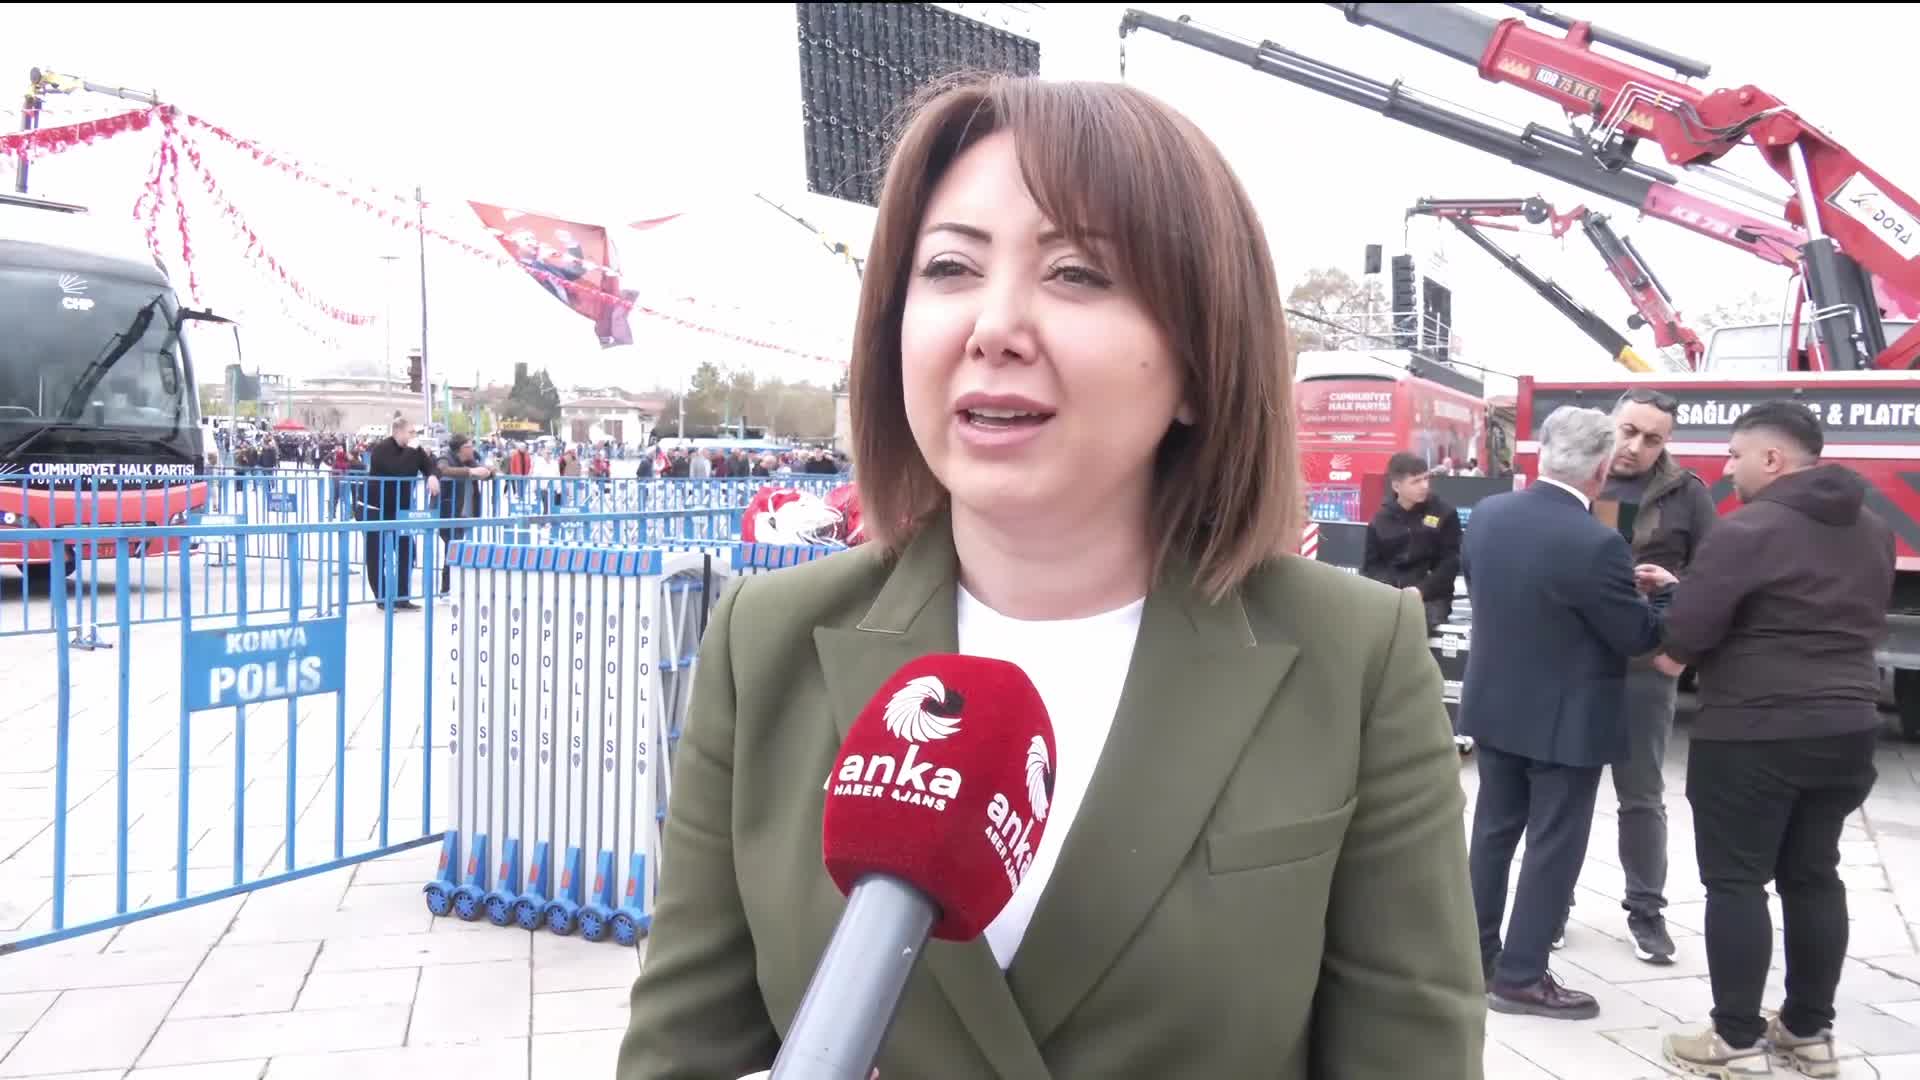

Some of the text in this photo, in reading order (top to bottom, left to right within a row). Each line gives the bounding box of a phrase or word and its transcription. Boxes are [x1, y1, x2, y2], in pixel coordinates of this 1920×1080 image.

[62, 297, 95, 310] CHP
[1827, 403, 1843, 425] &
[29, 463, 195, 476] CUMHURİYET HALK PARTİSİ
[226, 626, 307, 654] KONYA
[210, 650, 321, 704] POLİS
[839, 744, 962, 799] anka
[834, 784, 946, 812] HABER AJANS
